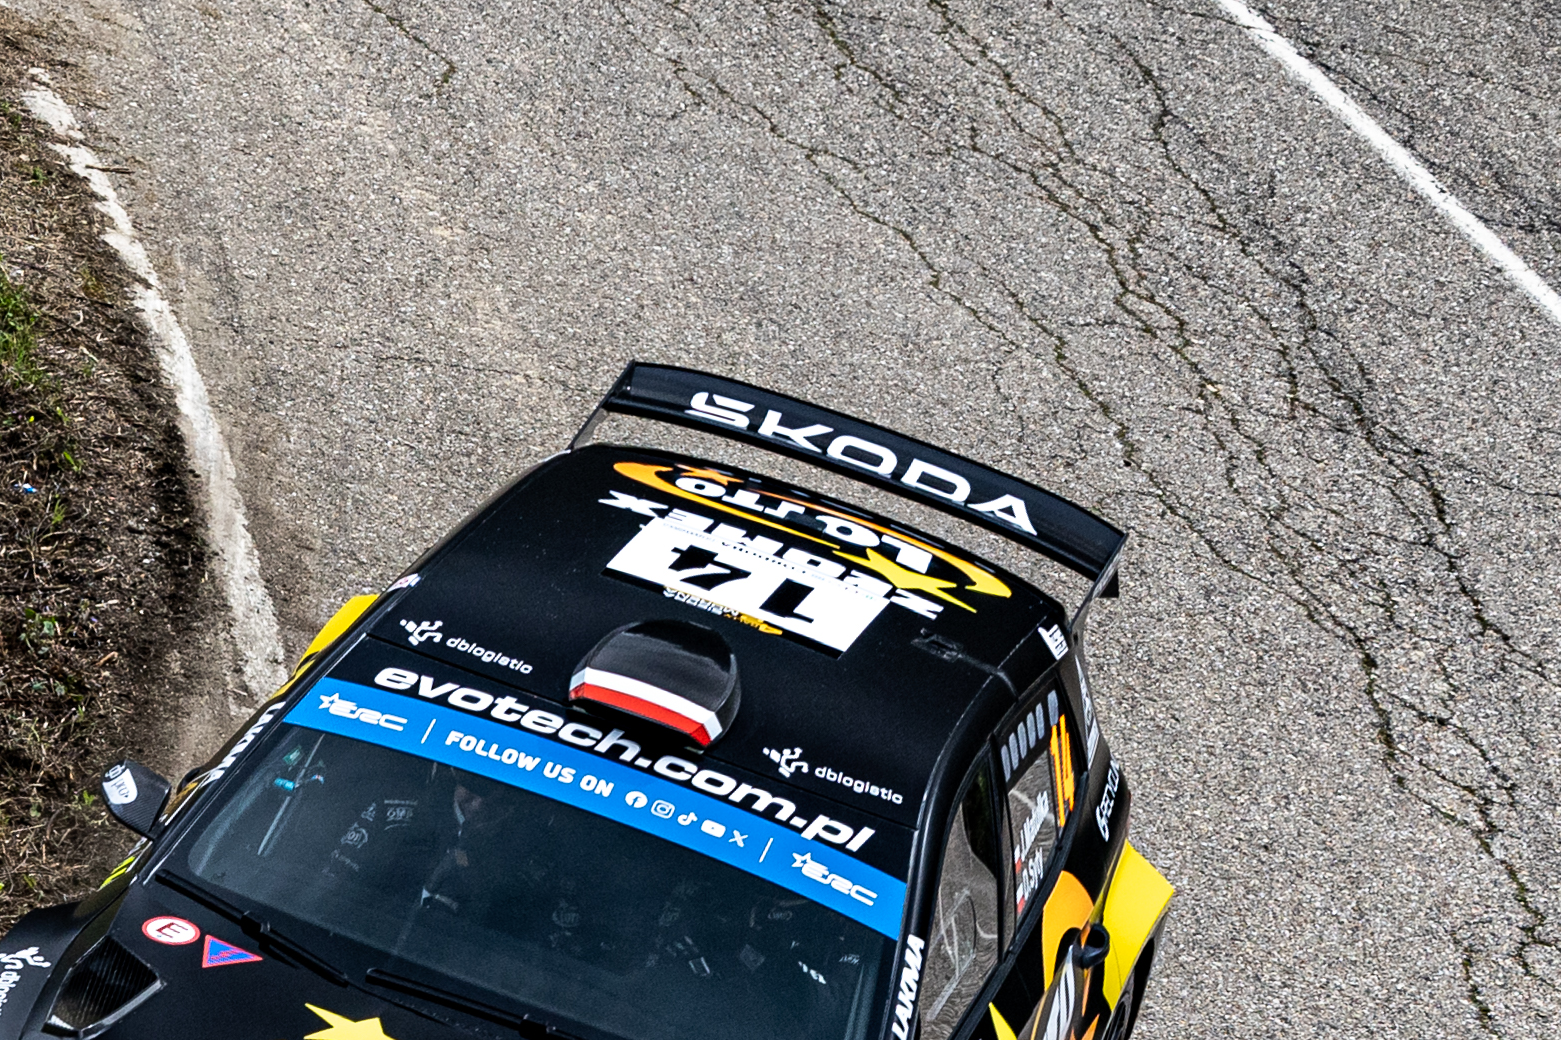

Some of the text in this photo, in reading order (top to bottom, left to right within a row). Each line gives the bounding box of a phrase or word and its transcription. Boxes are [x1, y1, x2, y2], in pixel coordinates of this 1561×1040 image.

[667, 542, 821, 624] 14
[445, 634, 533, 675] dblogistic
[373, 665, 876, 853] evotech.com.pl
[444, 729, 615, 798] FOLLOW US ON
[814, 764, 904, 805] dblogistic
